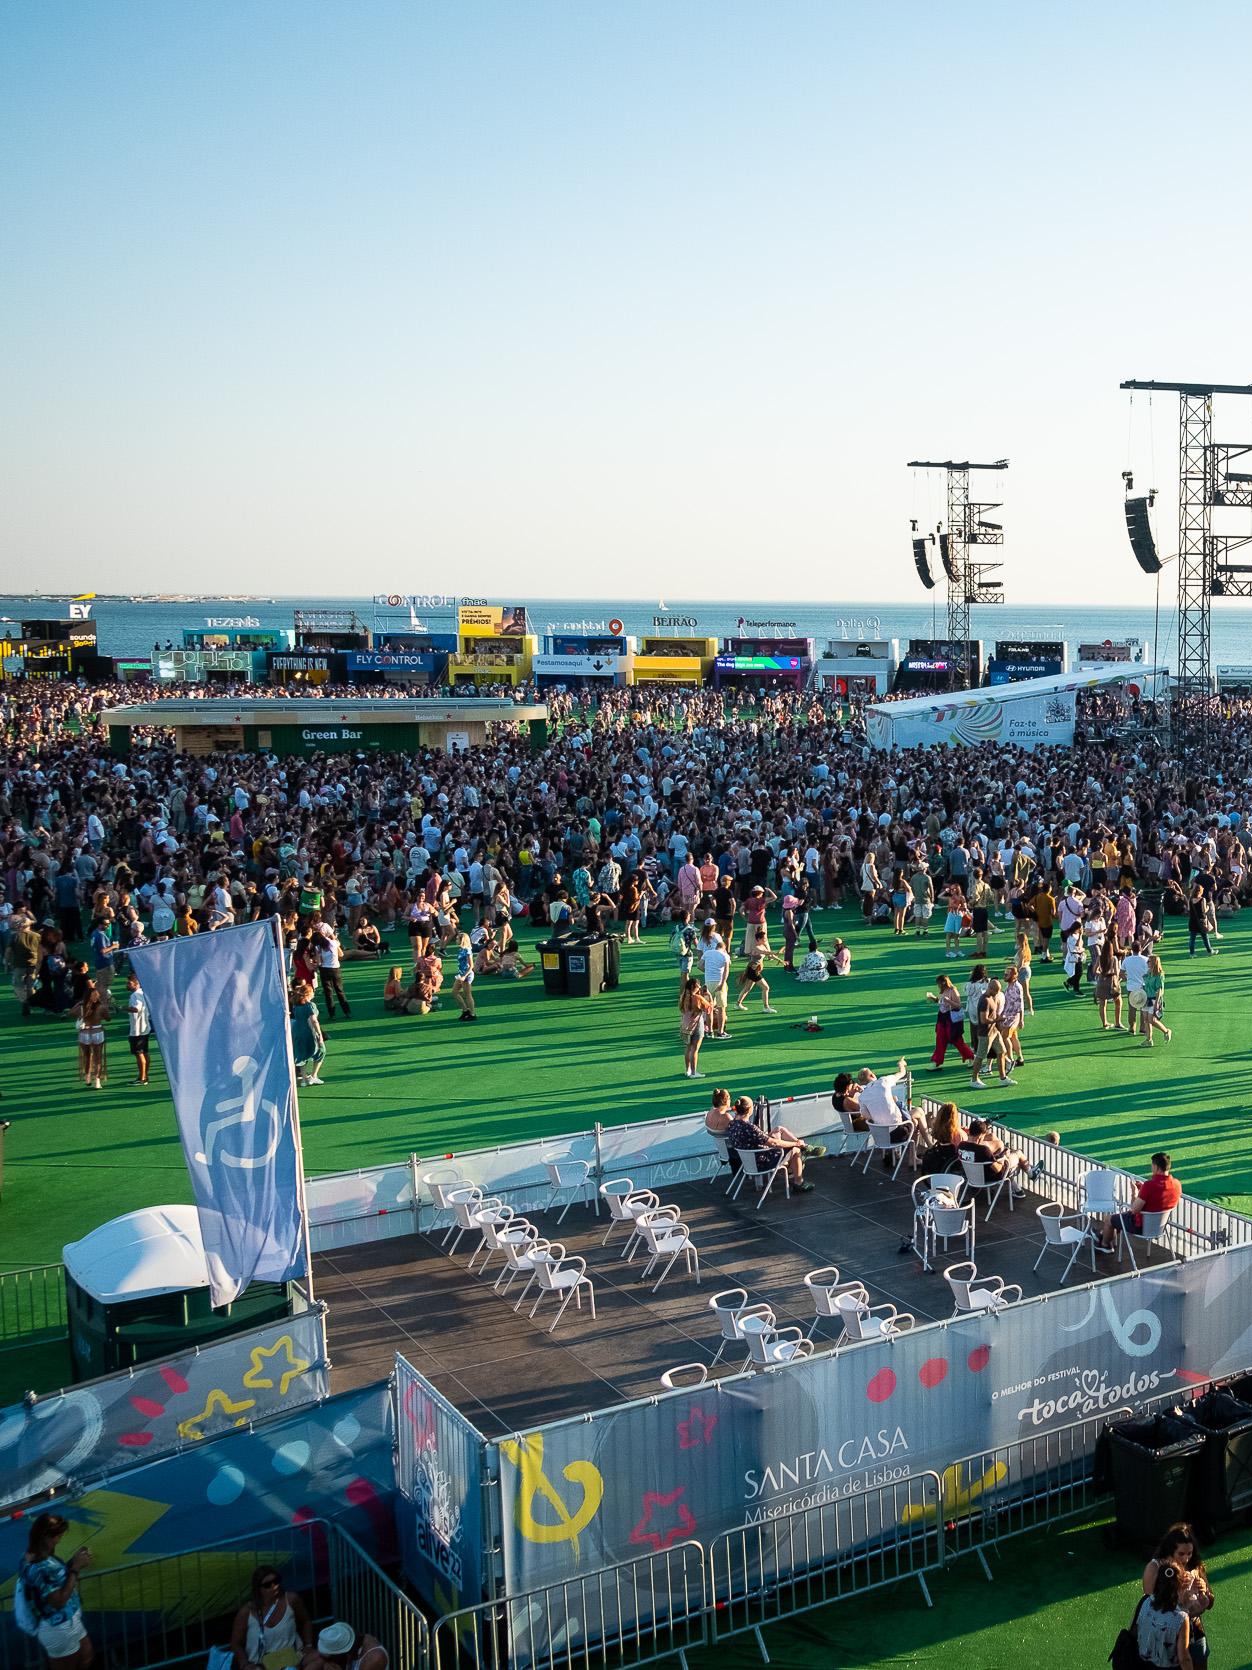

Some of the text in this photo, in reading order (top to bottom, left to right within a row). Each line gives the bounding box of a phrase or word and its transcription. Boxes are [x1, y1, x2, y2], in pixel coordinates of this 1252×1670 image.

[461, 597, 487, 606] fnac
[69, 604, 92, 619] EY
[205, 616, 260, 627] TEZENIS
[653, 616, 697, 628] BEIRÃO
[746, 620, 796, 628] Teleperformance
[273, 657, 328, 670] EVERYTHING IS NEW
[356, 655, 423, 665] FLY CONTROL
[537, 659, 583, 667] #estamosaqui
[1009, 719, 1037, 728] Faz-te
[302, 729, 362, 740] Green Bar
[1009, 728, 1049, 737] à música
[992, 1366, 1080, 1400] O MELHOR DO FESTIVAL
[744, 1426, 908, 1499] SANTA CASA
[744, 1464, 910, 1525] Misericórdia de Lisboa
